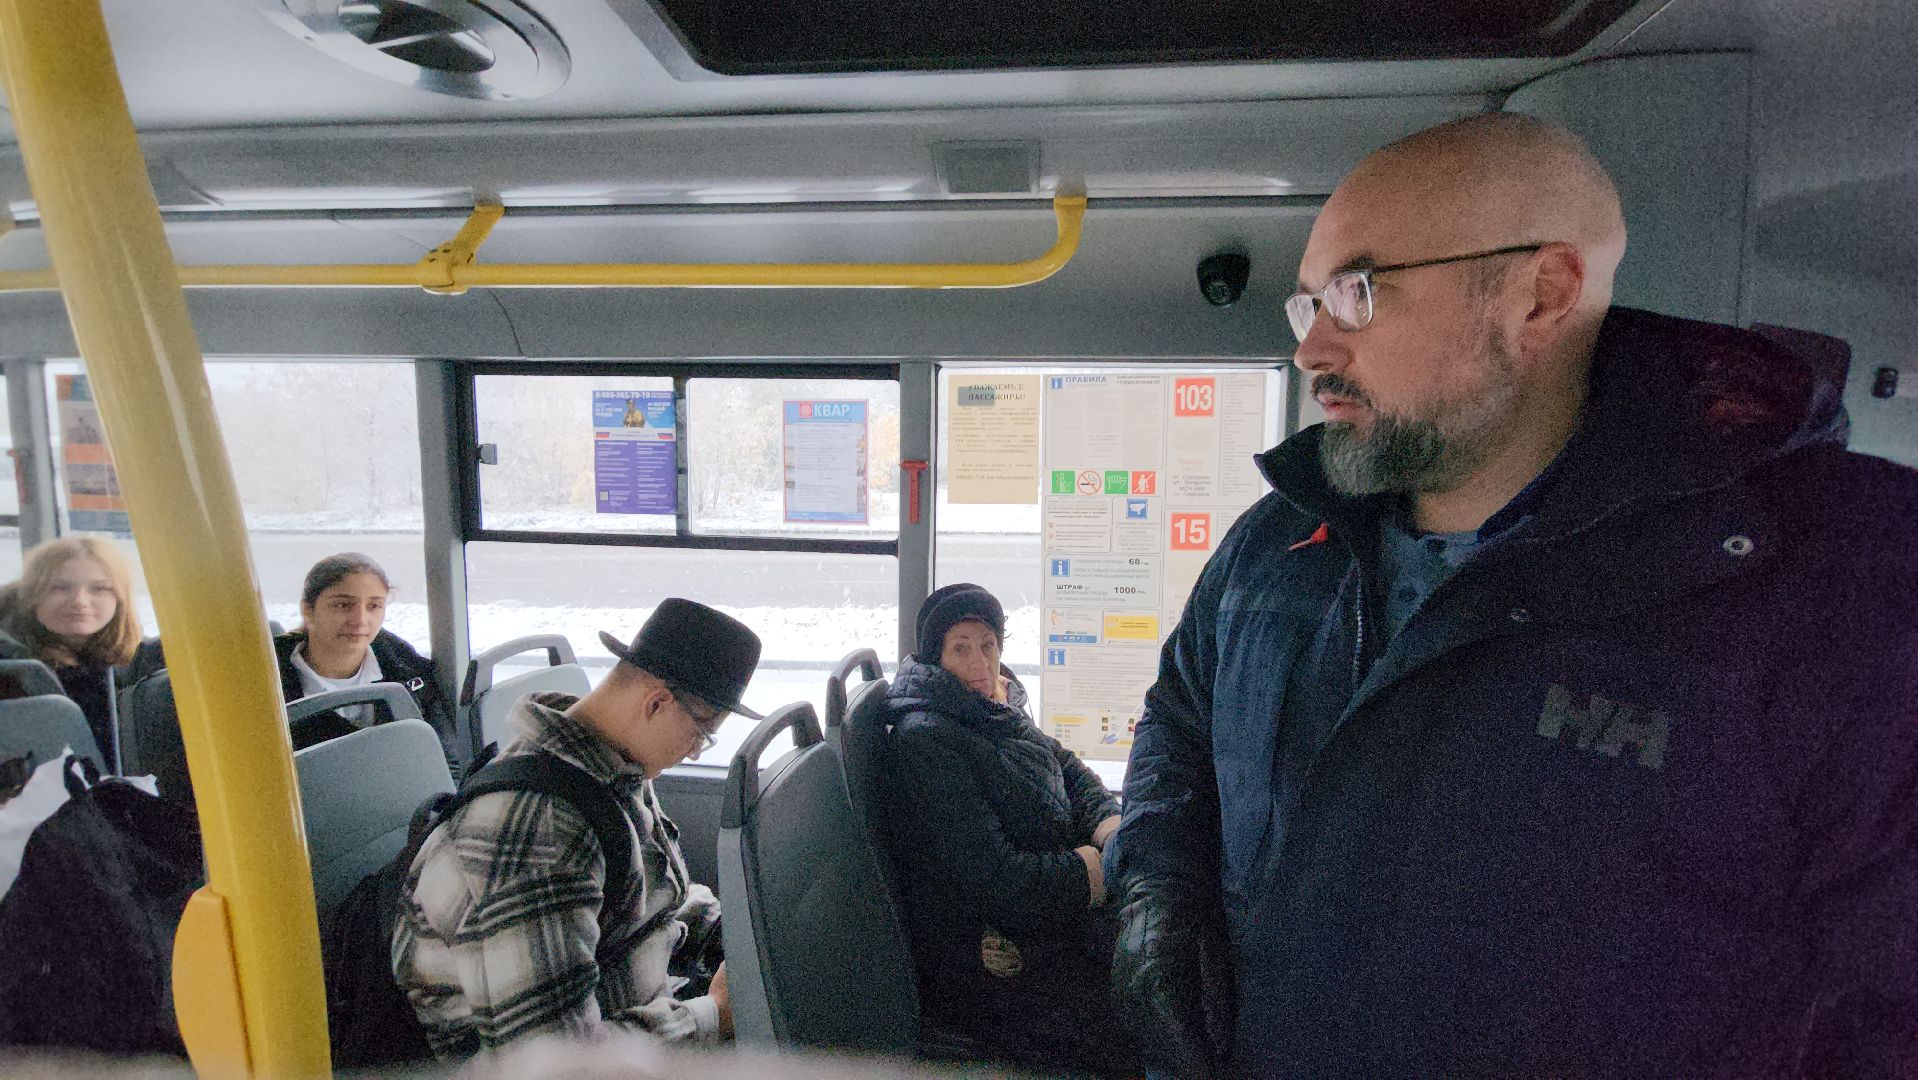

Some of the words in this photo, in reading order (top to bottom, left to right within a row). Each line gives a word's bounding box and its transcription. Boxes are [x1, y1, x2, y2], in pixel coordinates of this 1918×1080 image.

[1176, 385, 1213, 411] 103
[813, 404, 849, 417] КВАР
[1173, 518, 1206, 544] 15
[1114, 586, 1136, 595] 1000
